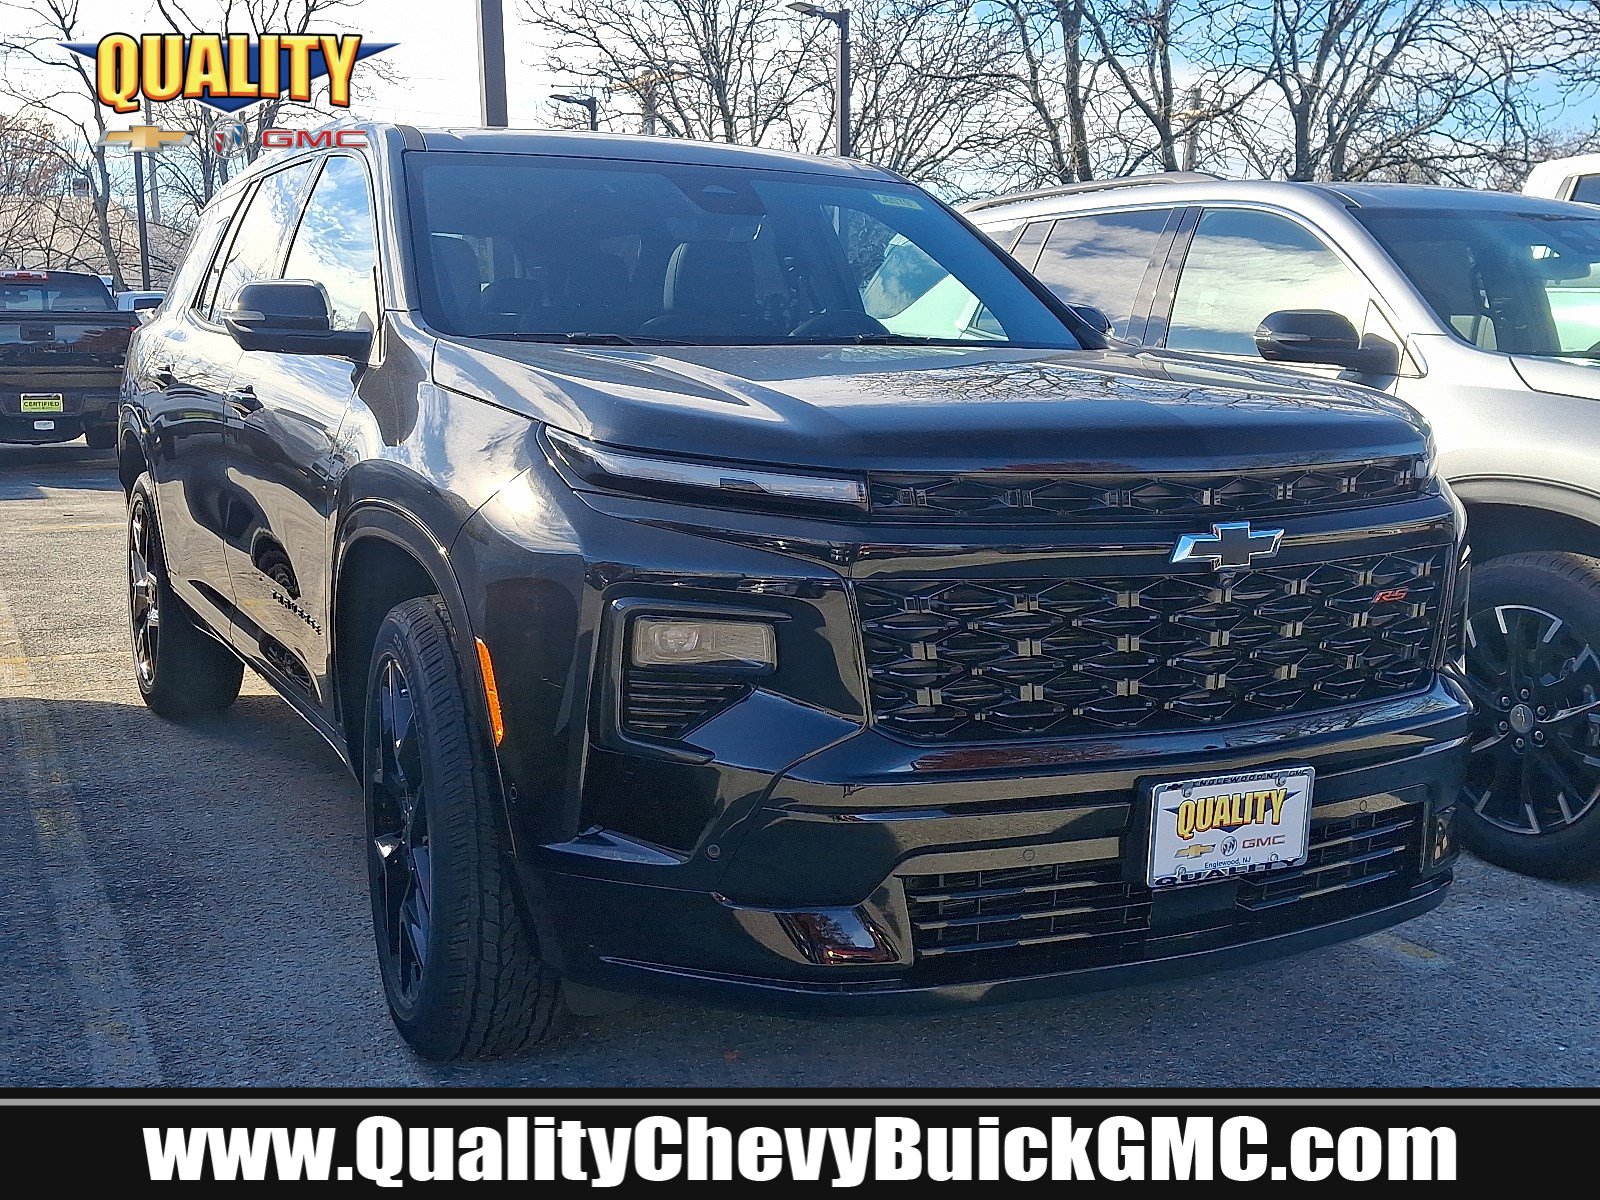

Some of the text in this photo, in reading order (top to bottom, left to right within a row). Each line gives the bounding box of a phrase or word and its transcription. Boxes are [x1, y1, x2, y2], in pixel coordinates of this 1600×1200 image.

[1372, 586, 1409, 604] RS
[1177, 788, 1288, 840] QUALITY
[1242, 835, 1286, 849] GMC
[1242, 856, 1252, 864] NJ
